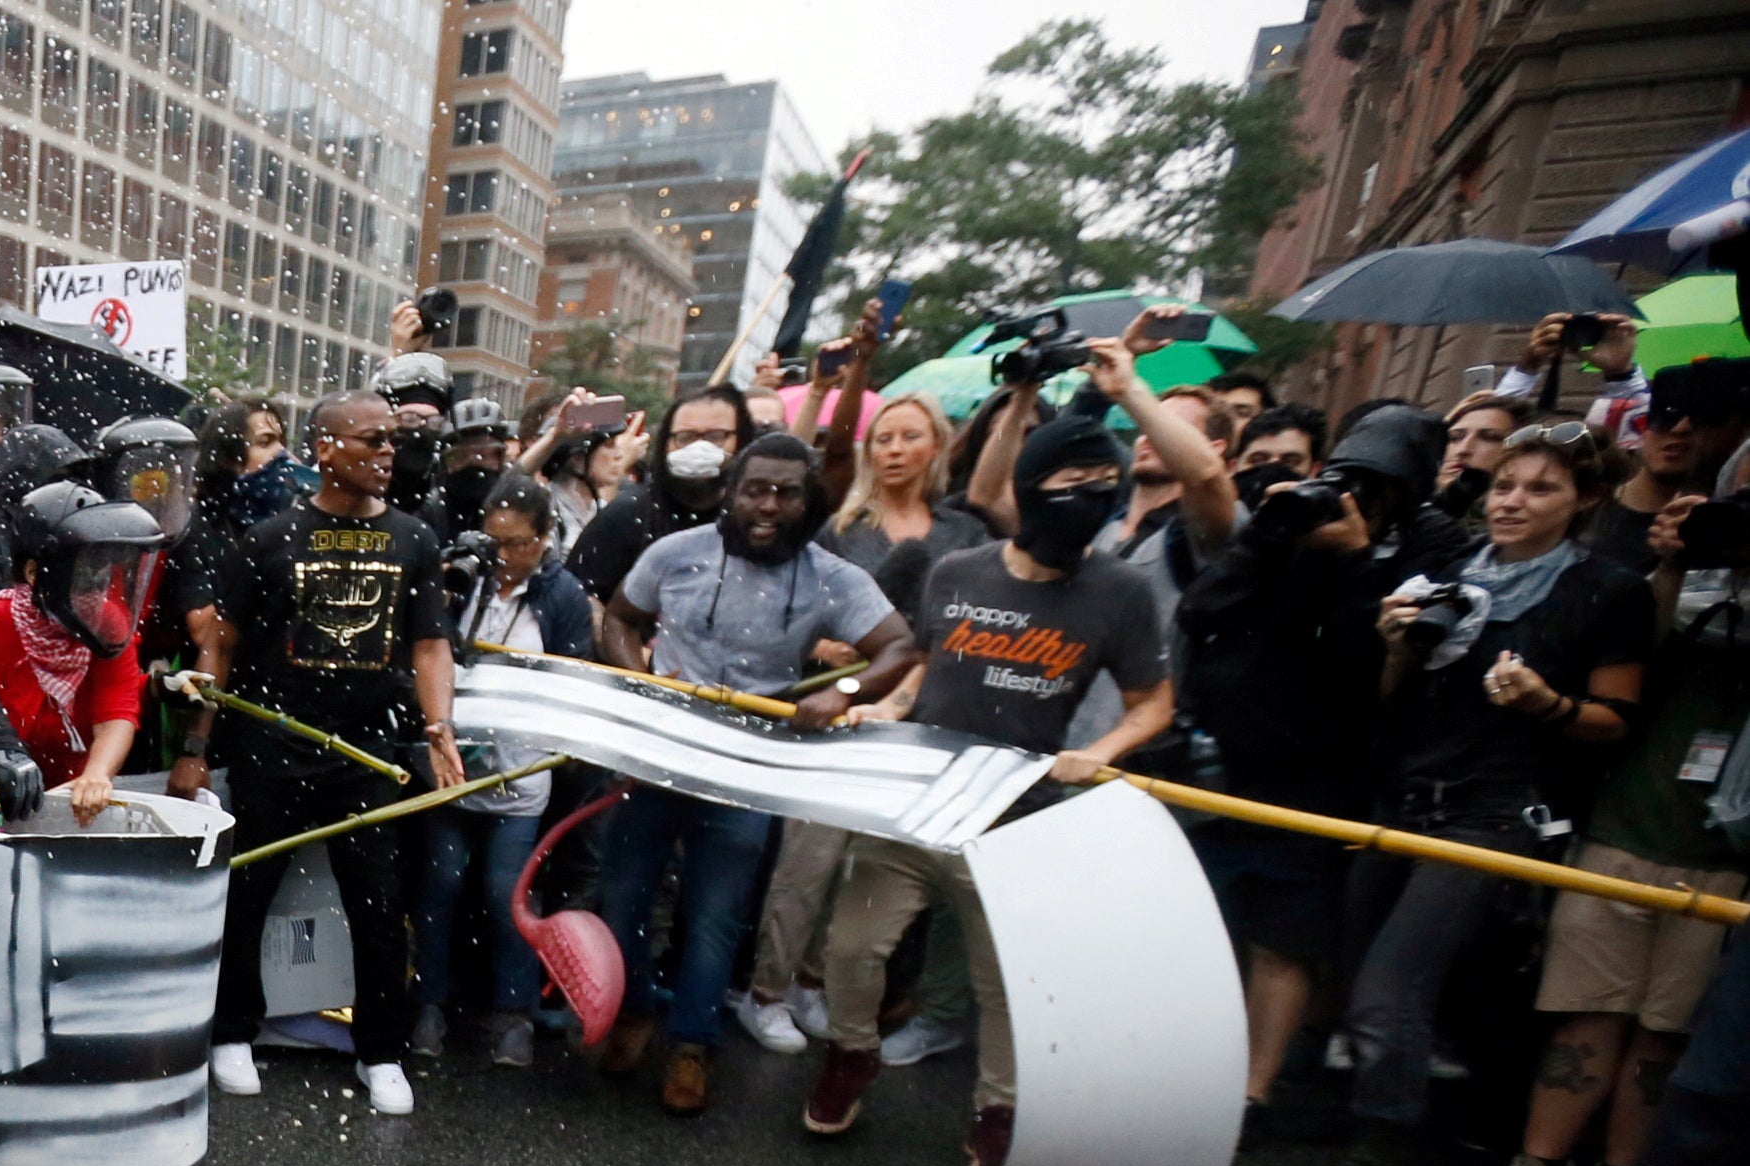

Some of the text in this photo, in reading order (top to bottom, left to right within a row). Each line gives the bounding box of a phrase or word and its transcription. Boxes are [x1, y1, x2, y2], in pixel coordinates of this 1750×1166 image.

[38, 265, 183, 303] NAZI PUNKS
[313, 530, 391, 551] DEBT
[942, 619, 1088, 680] healthy
